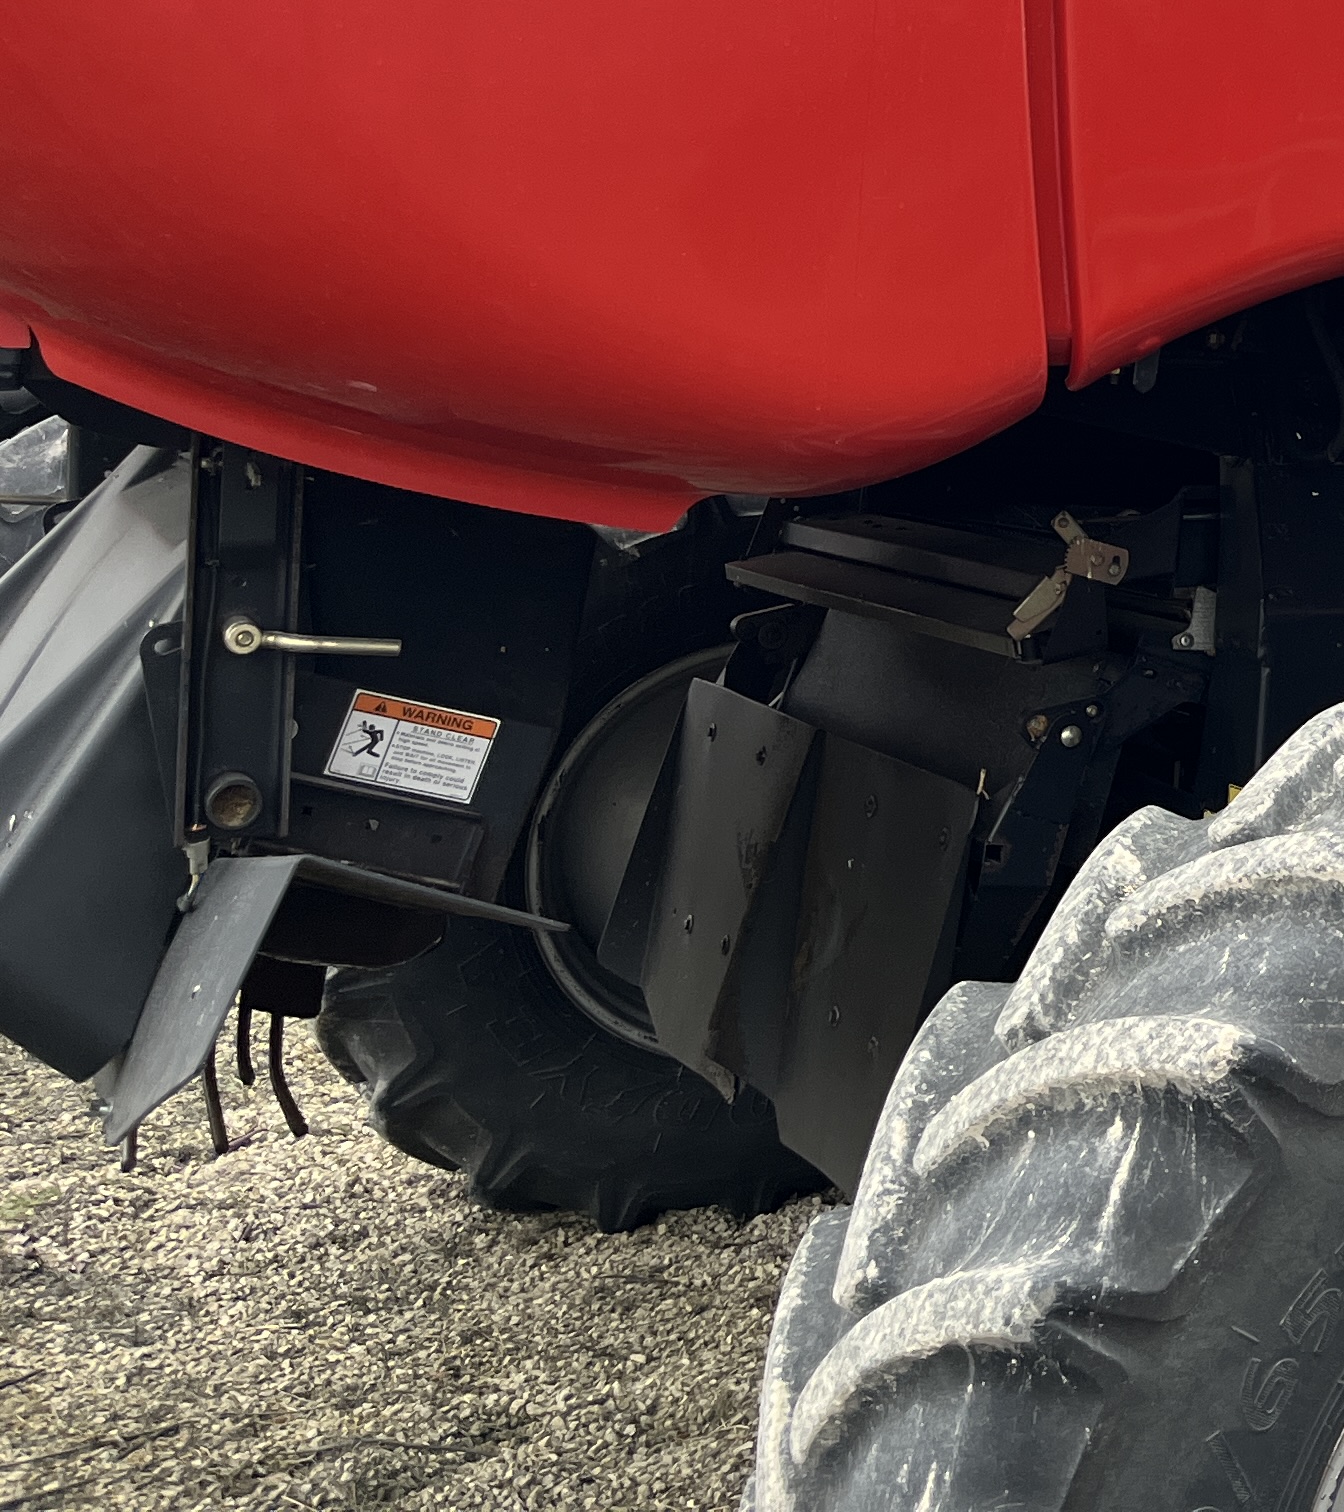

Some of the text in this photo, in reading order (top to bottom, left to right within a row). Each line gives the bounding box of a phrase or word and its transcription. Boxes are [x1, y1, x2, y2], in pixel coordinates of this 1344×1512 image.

[402, 706, 474, 731] WARNING
[411, 725, 475, 745] STAND CLEAR
